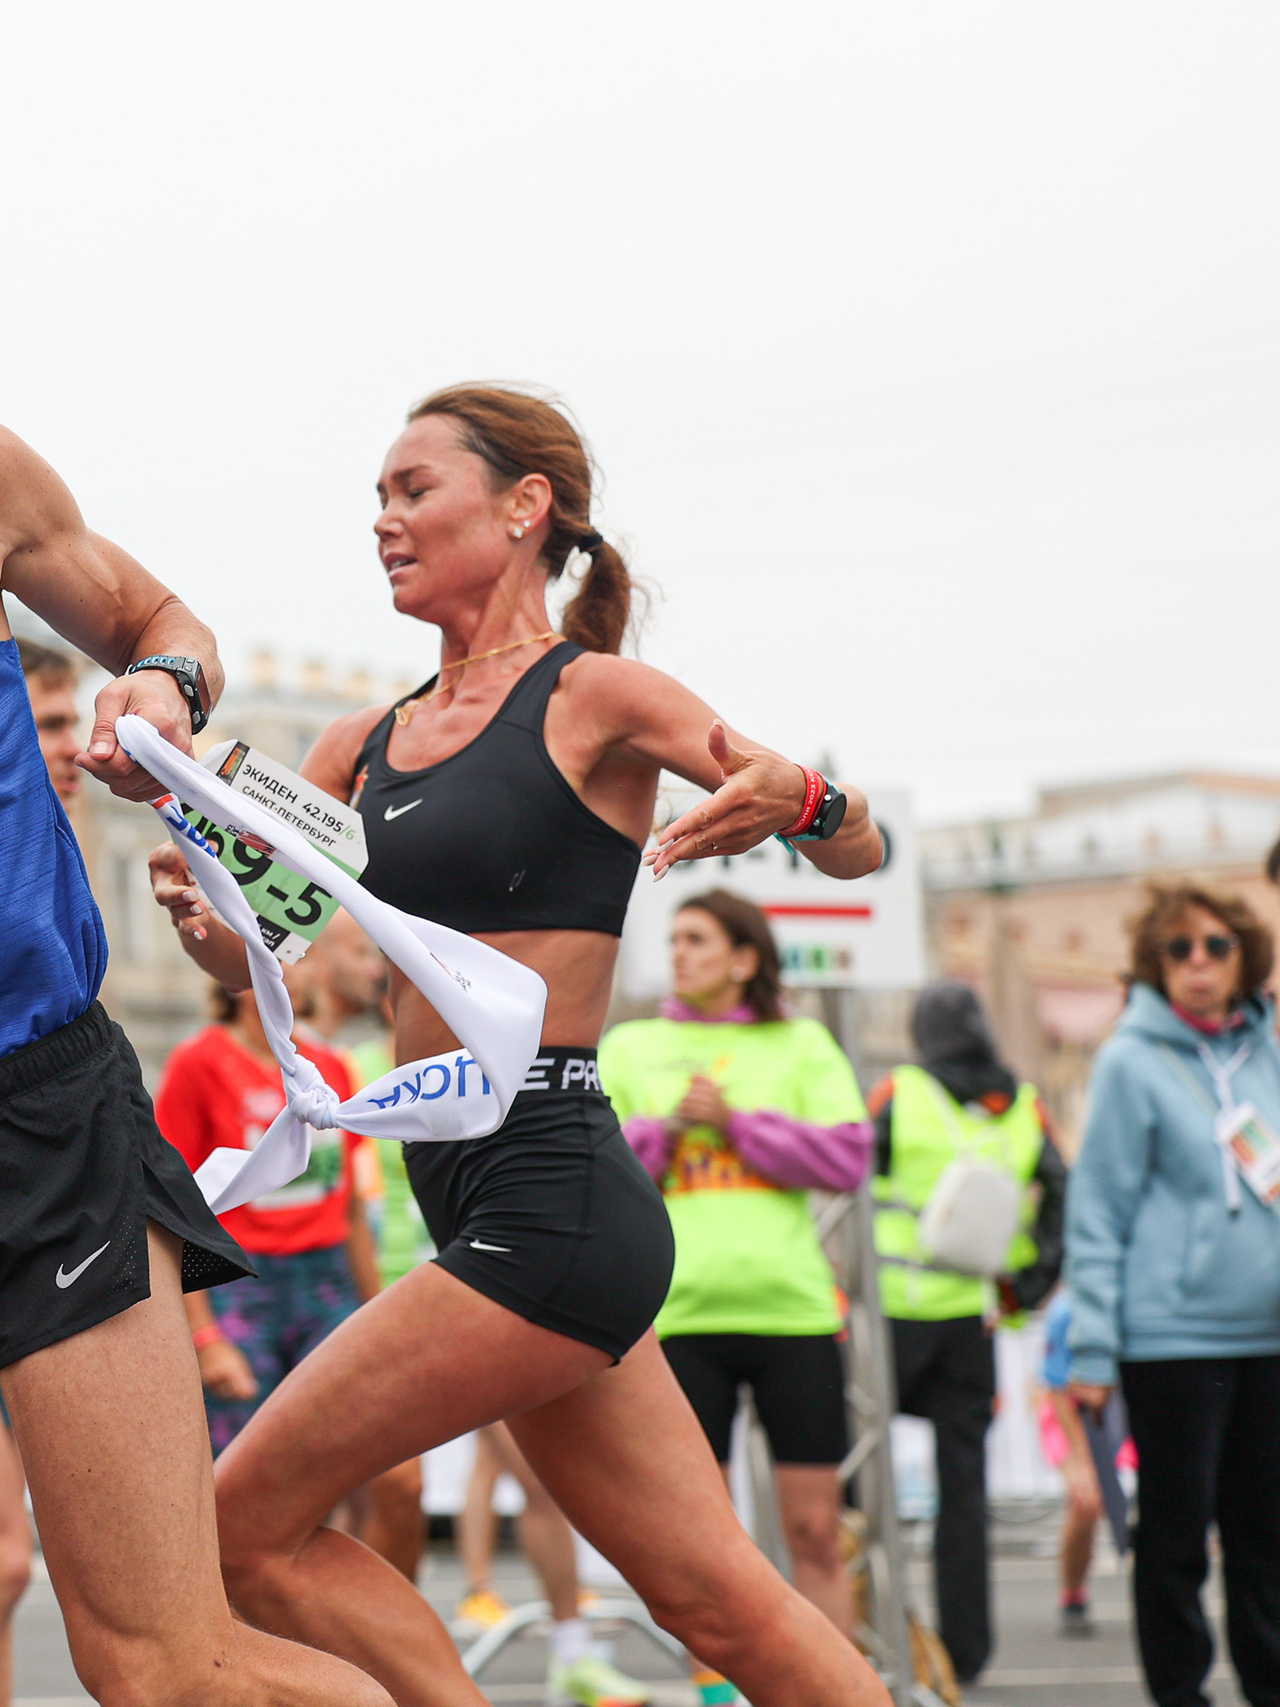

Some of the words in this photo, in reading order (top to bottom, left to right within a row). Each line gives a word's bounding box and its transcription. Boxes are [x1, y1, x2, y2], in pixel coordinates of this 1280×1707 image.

[242, 764, 299, 803] ЭКИДЕН
[302, 802, 356, 840] 42.195/6
[242, 785, 336, 848] САНКТ-ПЕТЕРБУРГ
[181, 803, 333, 926] 9-5
[367, 1056, 490, 1109] ЦСКА
[561, 1059, 604, 1092] PR
